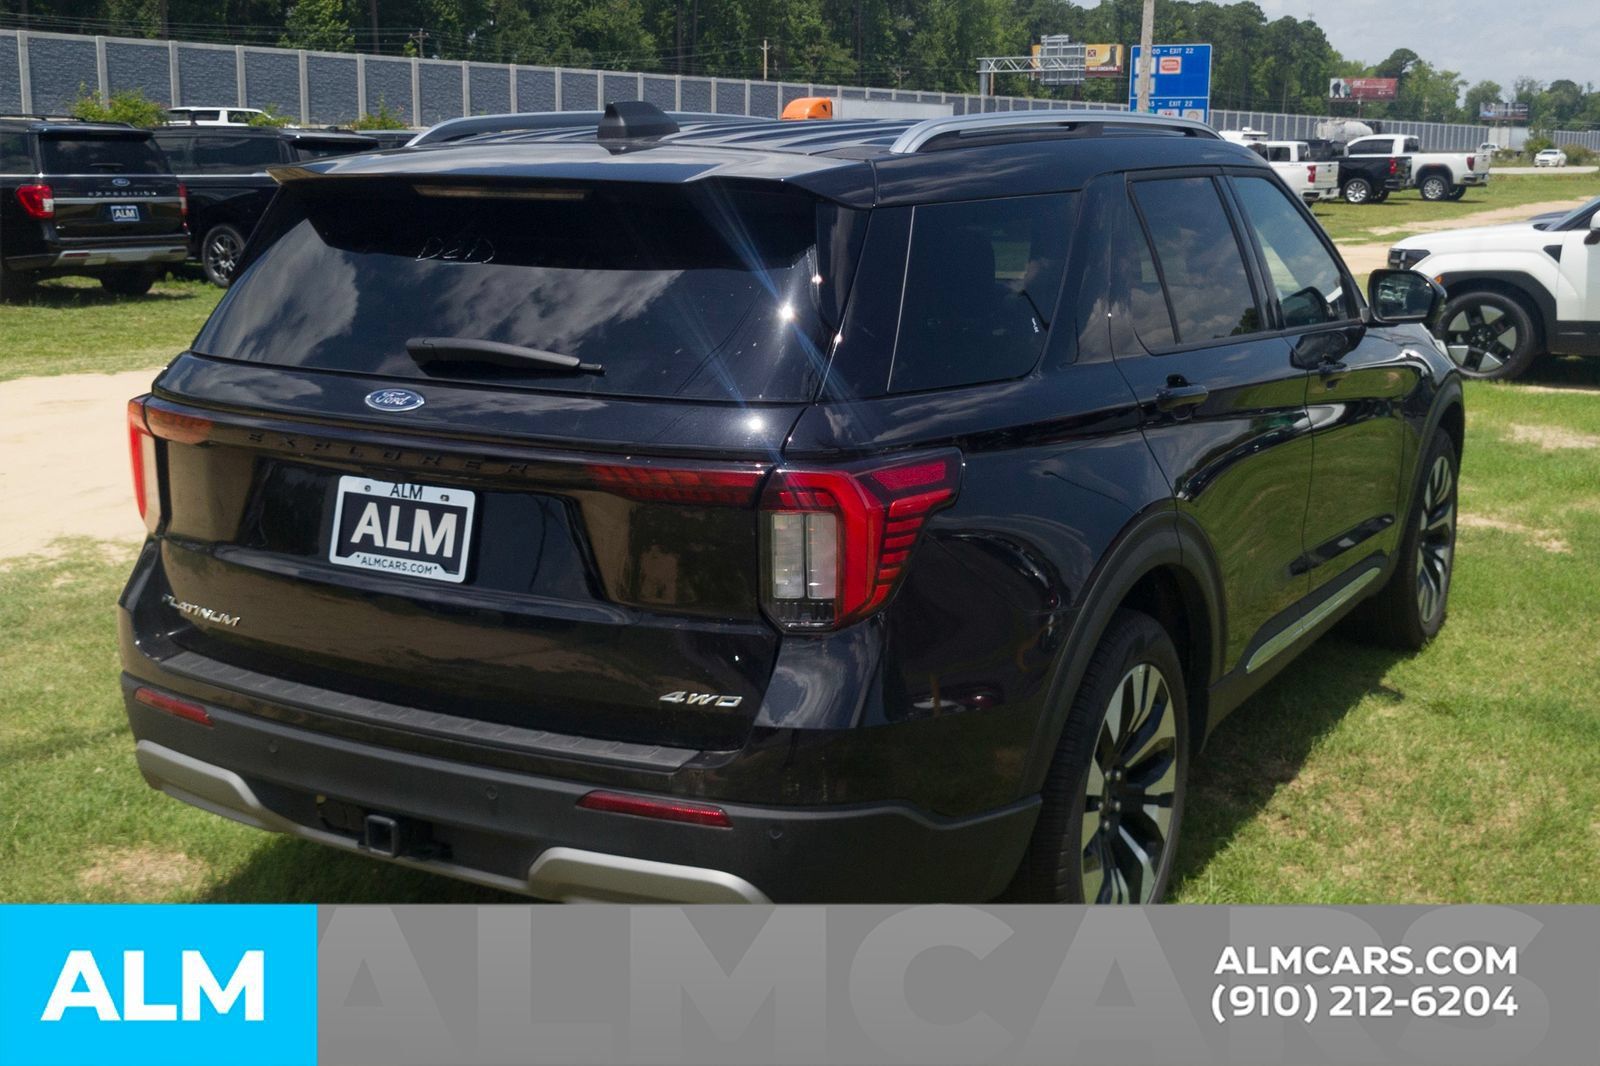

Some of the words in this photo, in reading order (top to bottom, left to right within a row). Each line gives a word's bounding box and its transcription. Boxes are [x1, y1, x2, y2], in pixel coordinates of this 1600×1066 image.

[115, 208, 136, 218] ALM
[374, 391, 414, 406] Ford
[389, 483, 424, 501] ALM
[350, 501, 458, 558] ALM
[360, 555, 434, 576] ALMCARS.COM
[161, 593, 241, 628] PLATINUM
[659, 690, 743, 707] 4WD
